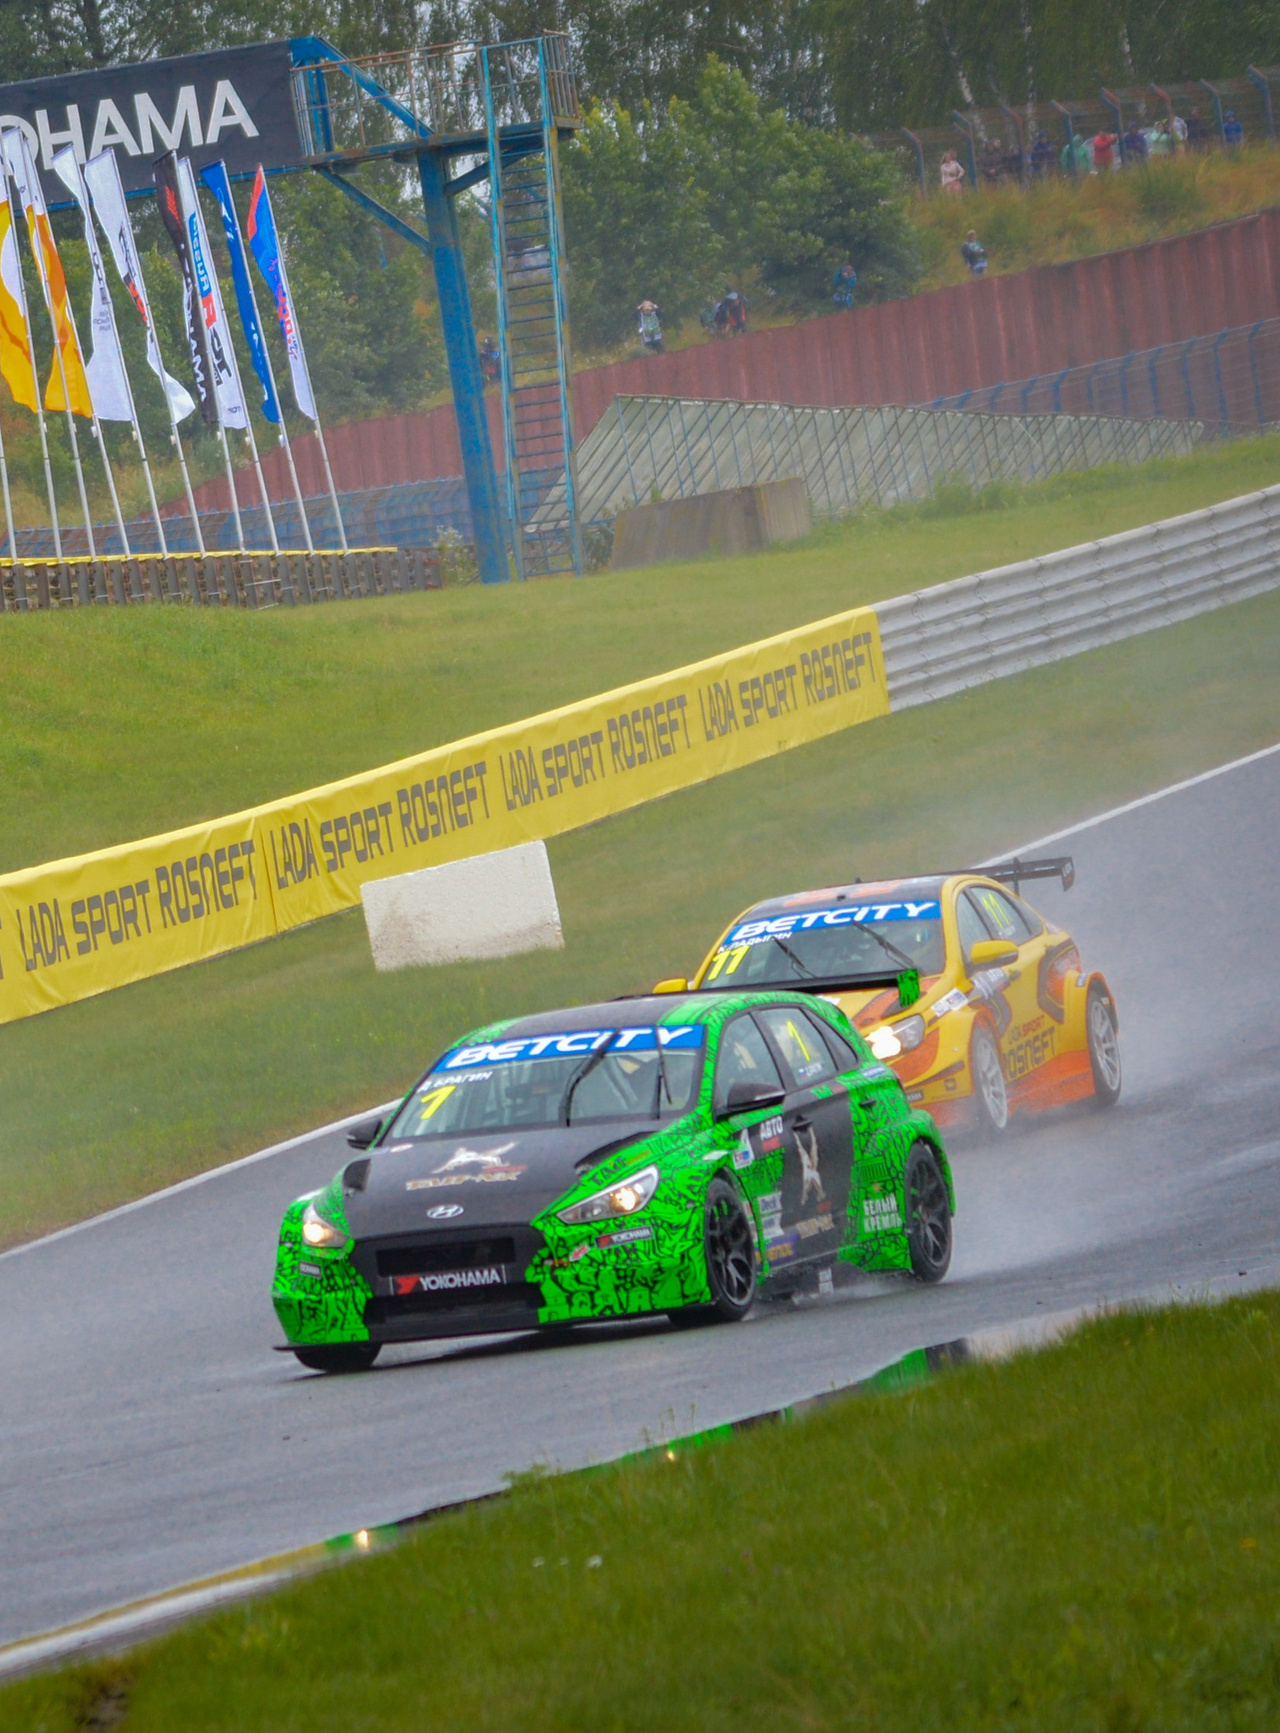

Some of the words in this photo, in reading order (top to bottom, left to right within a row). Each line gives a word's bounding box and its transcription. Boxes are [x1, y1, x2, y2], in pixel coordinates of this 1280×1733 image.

[699, 680, 738, 741] LADA
[739, 664, 797, 727] SPORT
[800, 632, 876, 706] ROSNEFT
[499, 746, 543, 812] LADA
[543, 731, 606, 797] SPORT
[607, 694, 691, 774] ROSNEFT
[270, 819, 319, 890] LADA
[321, 801, 394, 872] SPORT
[397, 761, 490, 848] ROSNEFT
[17, 899, 71, 972] LADA
[72, 879, 152, 956] SPORT
[155, 839, 257, 929] ROSNEFT
[731, 902, 936, 941] BETCITY
[708, 945, 751, 981] 11
[446, 1027, 694, 1069] BETCITY
[786, 1020, 811, 1062] 1
[421, 1085, 456, 1120] 1
[419, 1267, 501, 1292] YOKOHAMA
